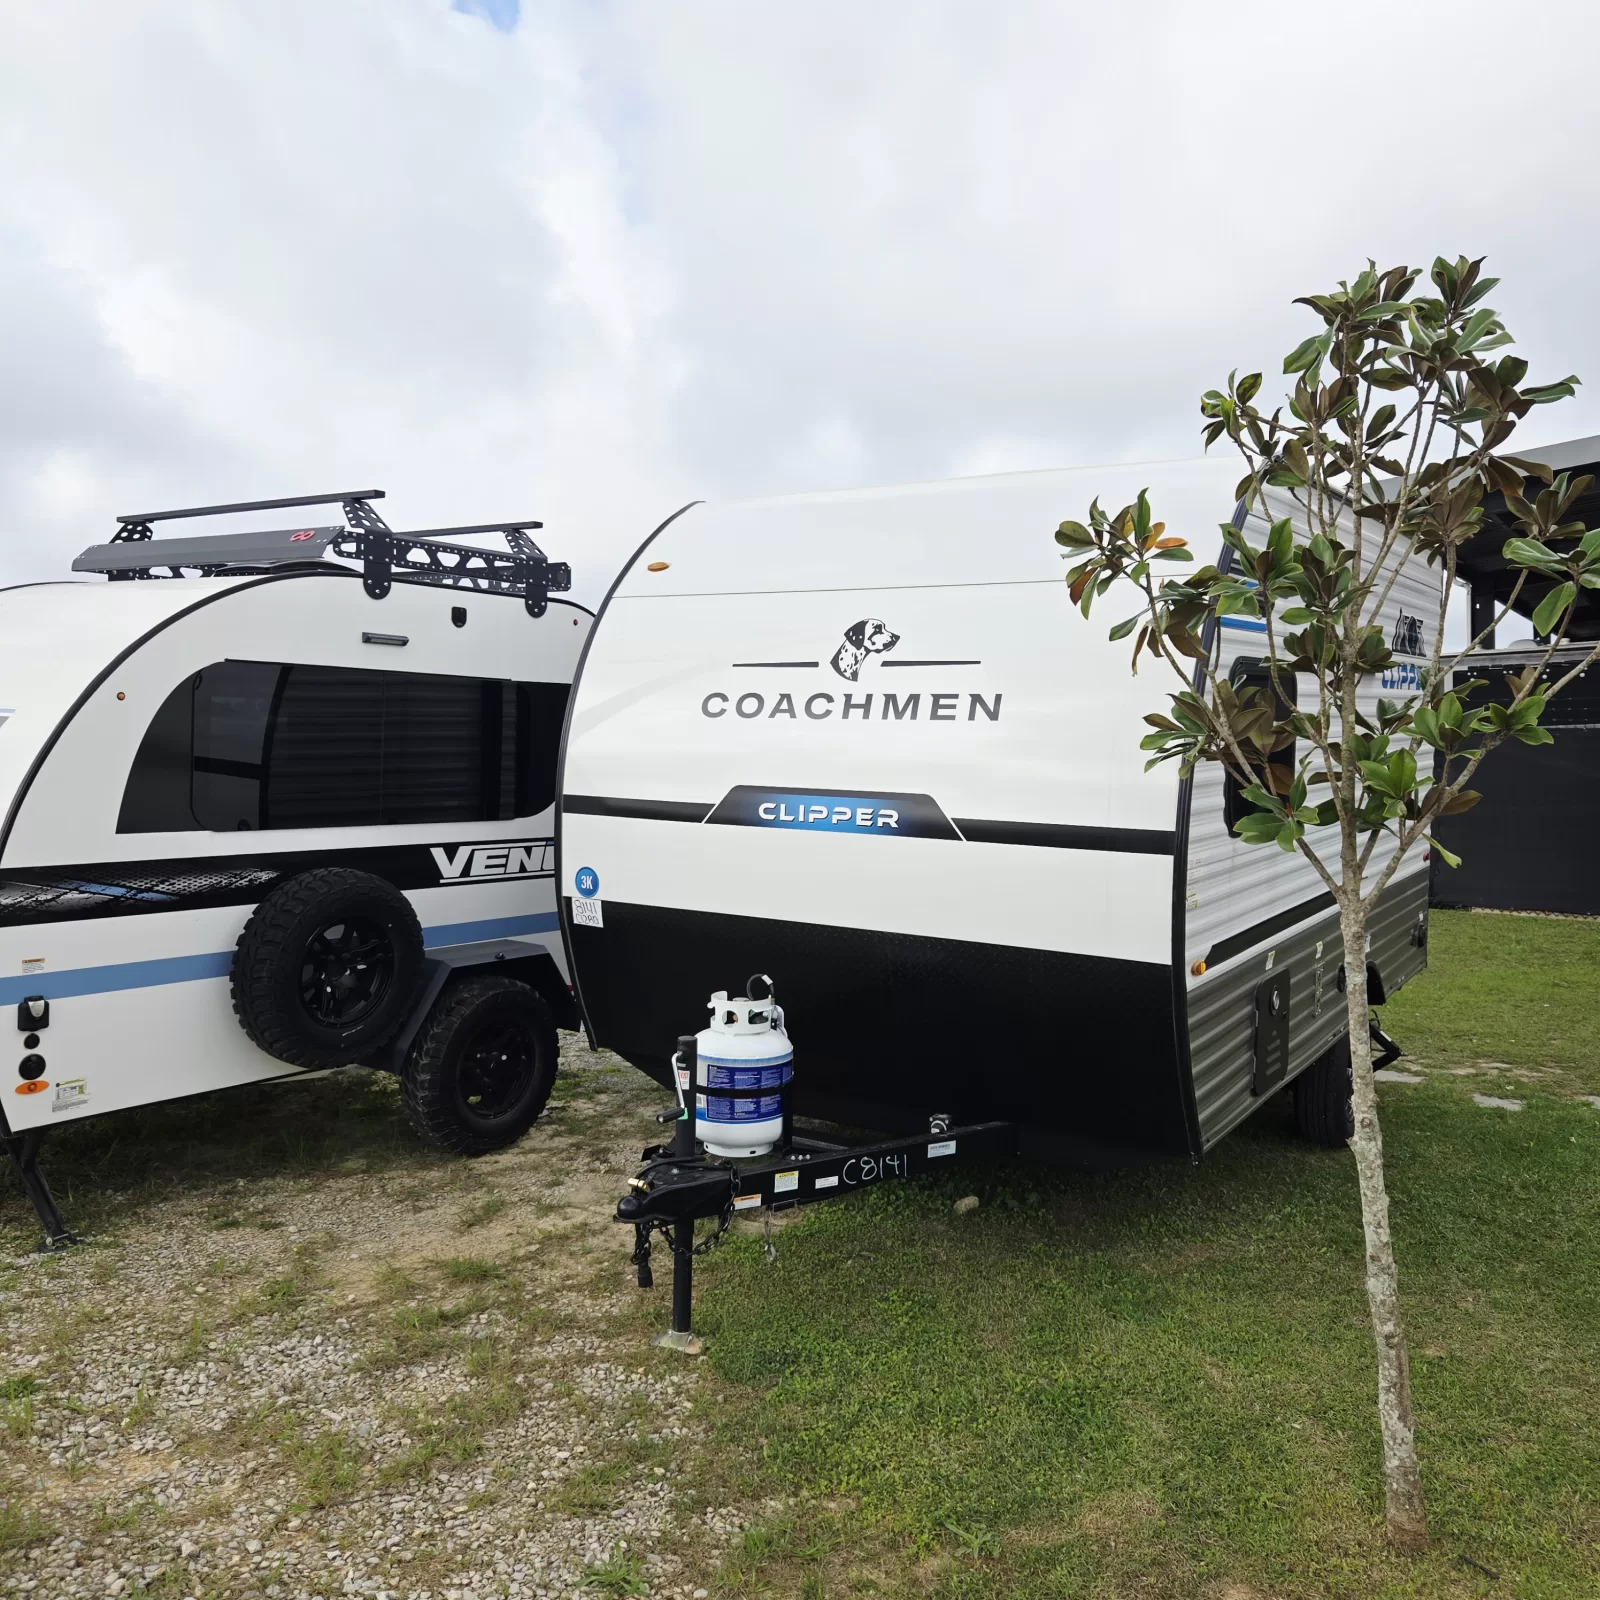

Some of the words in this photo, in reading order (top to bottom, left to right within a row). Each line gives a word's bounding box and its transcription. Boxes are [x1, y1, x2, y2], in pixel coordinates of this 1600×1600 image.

[701, 692, 1003, 721] COACHMEN
[758, 802, 899, 828] CLIPPER
[580, 875, 593, 890] 3K
[574, 899, 598, 914] 8141
[842, 1153, 908, 1185] C8141
